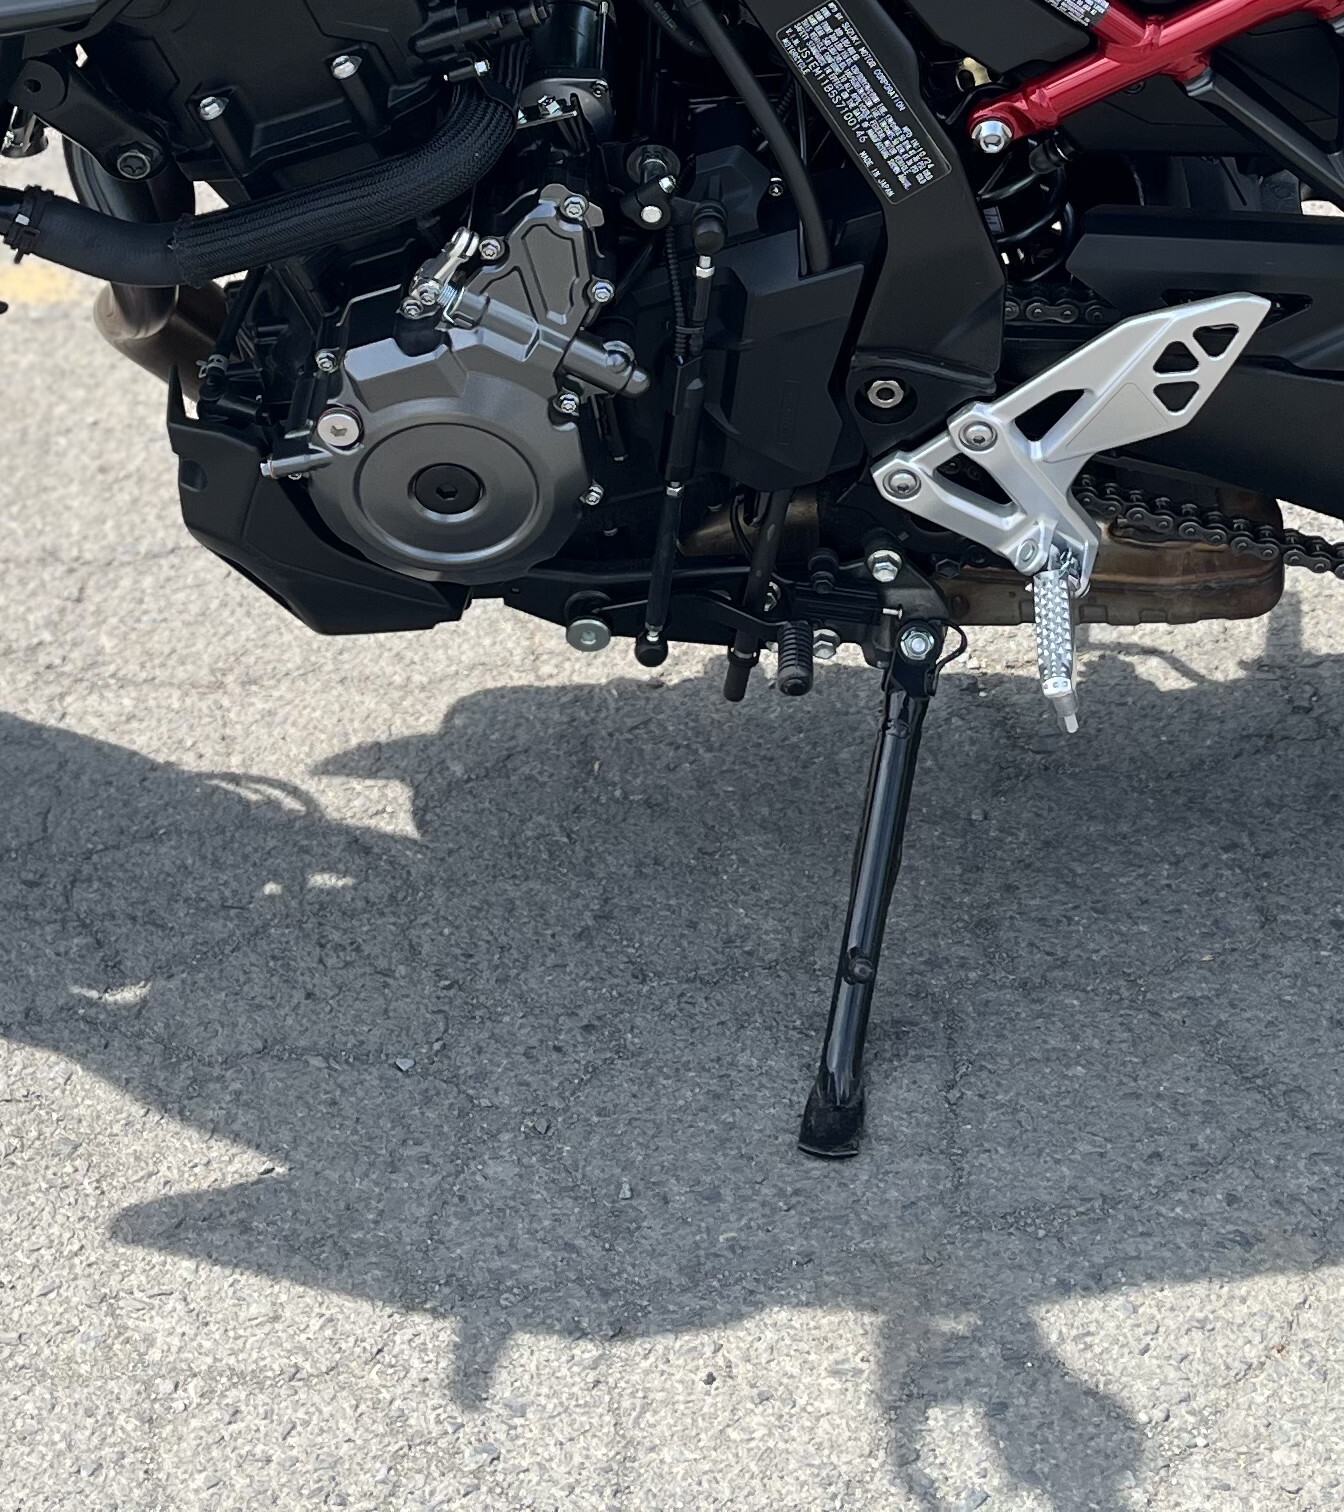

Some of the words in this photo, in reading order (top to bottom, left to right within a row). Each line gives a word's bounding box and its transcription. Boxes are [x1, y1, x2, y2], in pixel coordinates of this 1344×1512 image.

[840, 21, 862, 46] SUZUKI
[857, 46, 877, 68] MOTOR
[872, 67, 907, 112] CORPORATION
[876, 176, 894, 198] JAPAN
